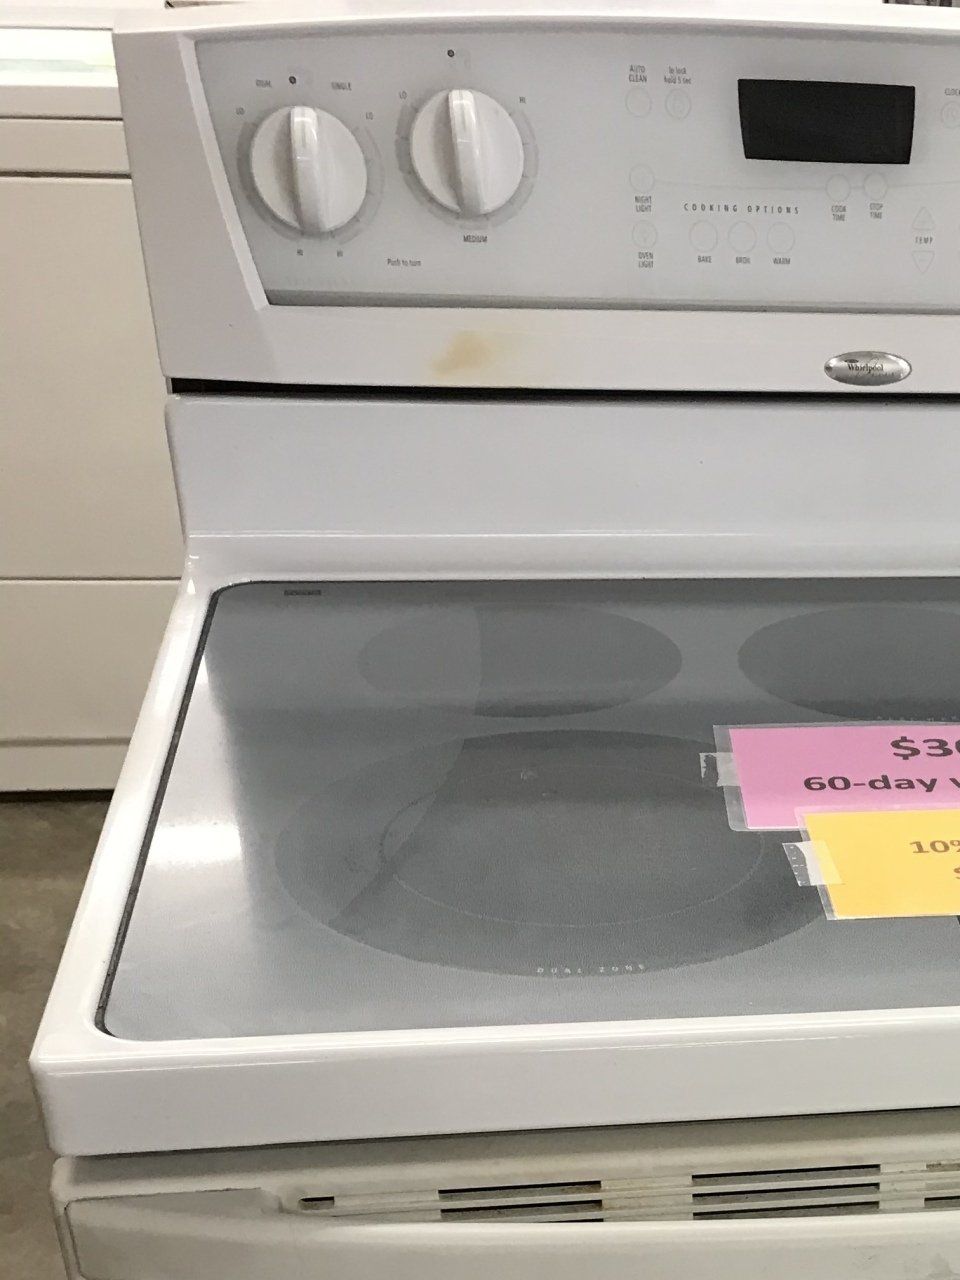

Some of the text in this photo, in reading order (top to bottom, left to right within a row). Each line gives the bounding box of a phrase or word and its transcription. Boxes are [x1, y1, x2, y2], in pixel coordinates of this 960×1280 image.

[628, 74, 648, 83] CLEAN
[683, 202, 799, 215] COOKING OPTIONS
[463, 234, 488, 243] MEDIUM
[697, 255, 712, 264] BAKE
[773, 257, 791, 265] WARM
[803, 774, 938, 793] 60-day
